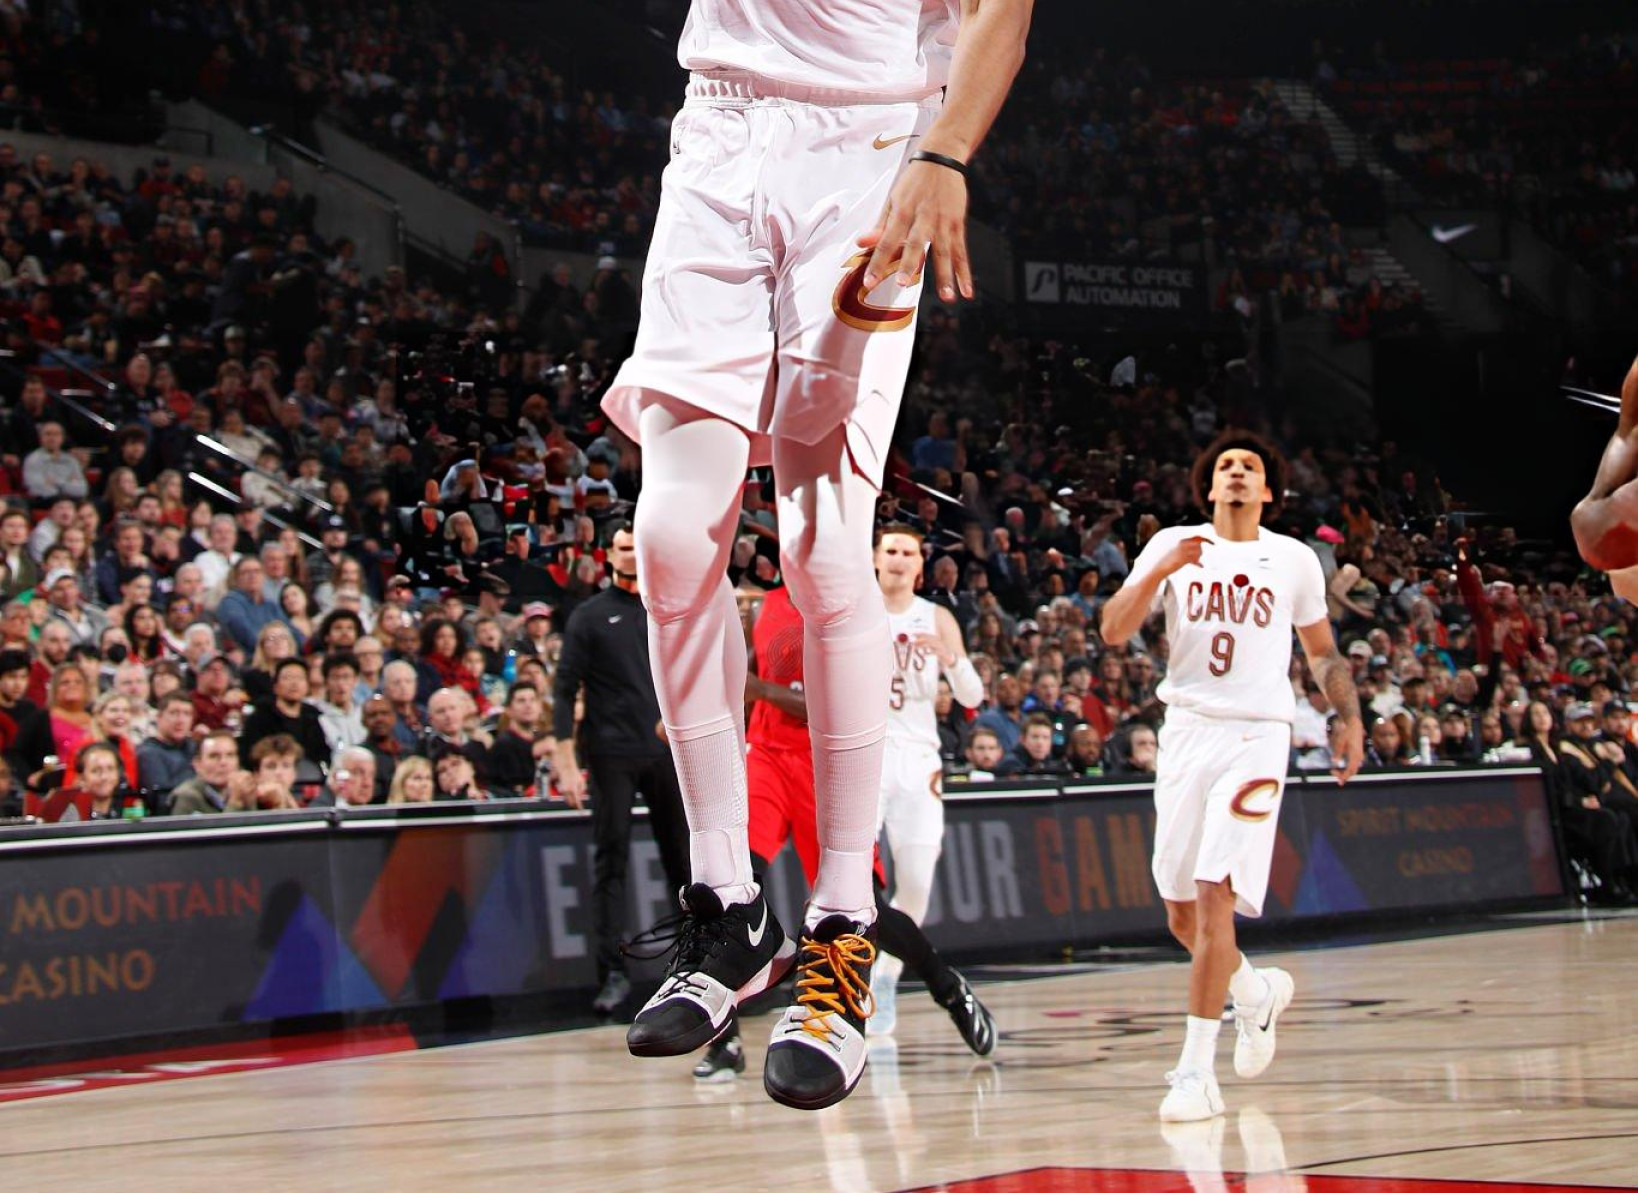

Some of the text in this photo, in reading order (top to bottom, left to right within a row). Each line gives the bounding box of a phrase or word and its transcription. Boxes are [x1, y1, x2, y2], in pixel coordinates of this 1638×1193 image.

[1063, 264, 1194, 288] PACIFIC OFFICE
[1065, 285, 1181, 308] AUTOMATION
[1187, 580, 1275, 628] CAVS
[1208, 631, 1236, 677] 9
[889, 676, 905, 711] 5
[1035, 812, 1155, 916] GAM
[10, 875, 262, 934] MOUNTAIN
